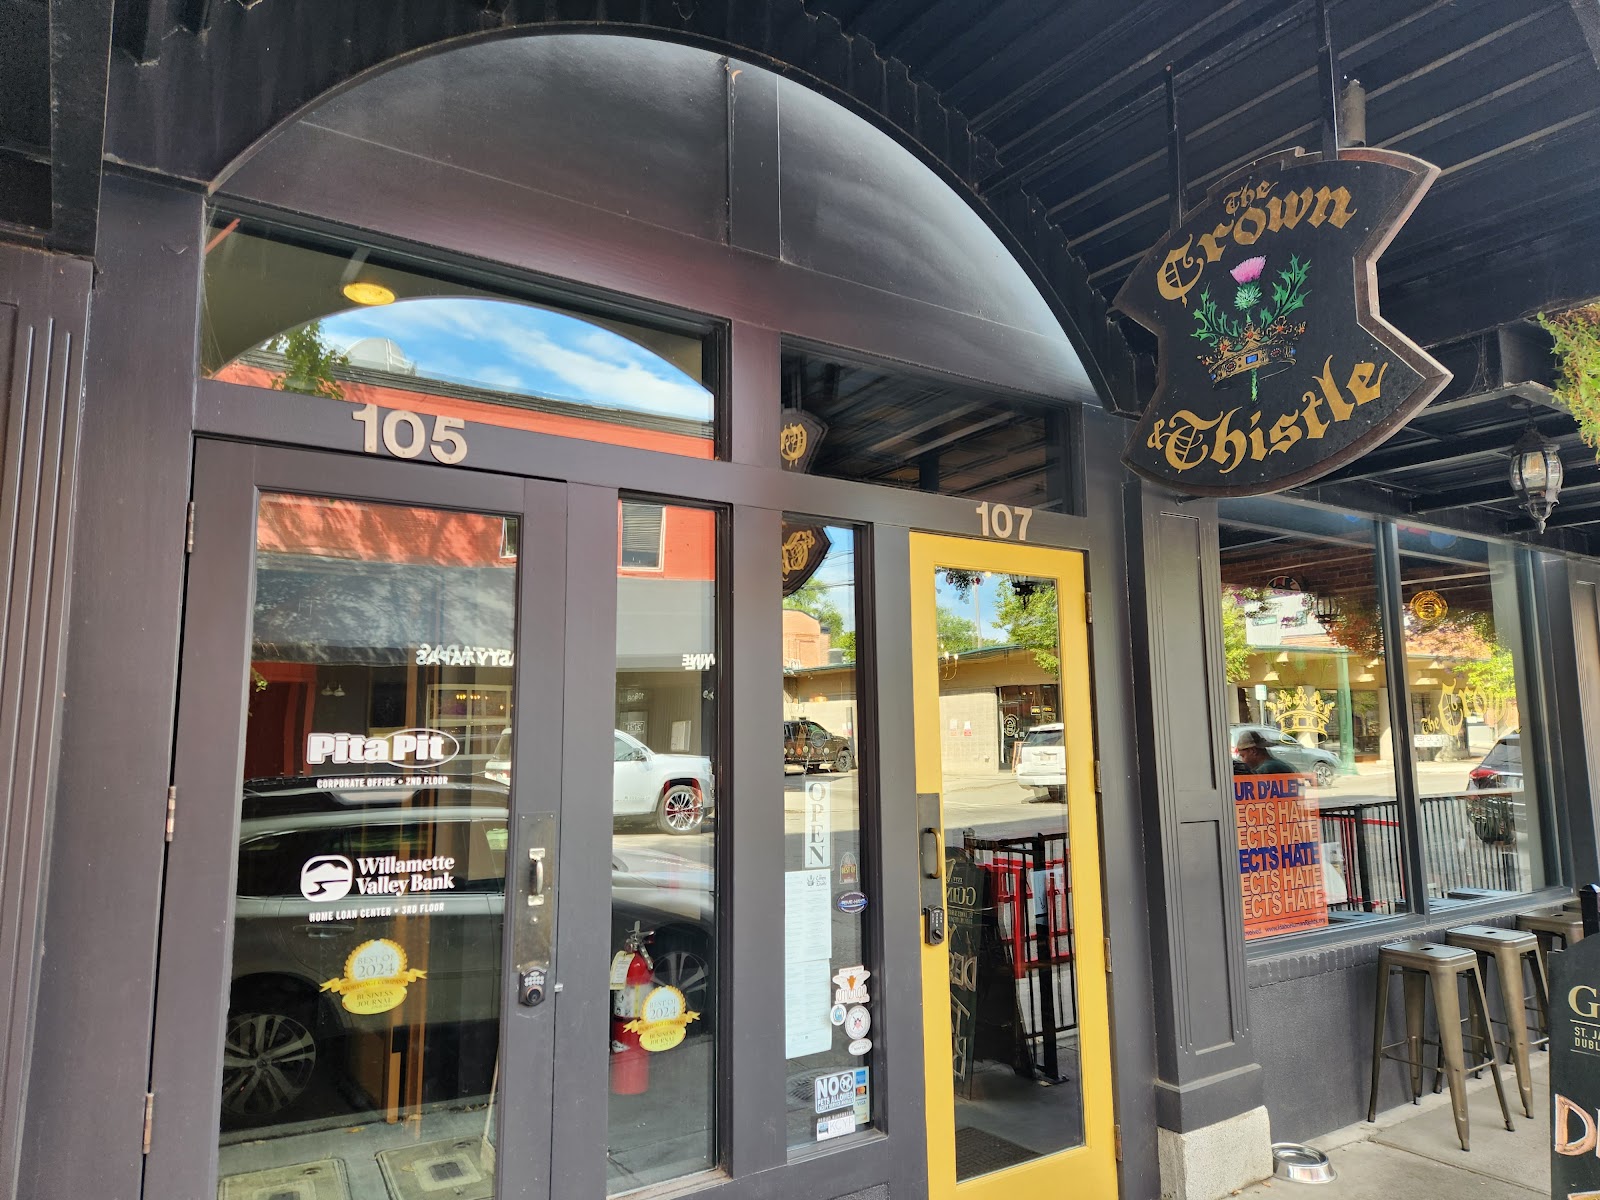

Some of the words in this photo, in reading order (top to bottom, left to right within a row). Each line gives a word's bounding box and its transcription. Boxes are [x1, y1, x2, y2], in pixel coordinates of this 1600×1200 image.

[1223, 180, 1279, 216] The
[1156, 185, 1357, 308] Crown
[1147, 418, 1166, 451] &
[1164, 355, 1389, 473] Thistle
[352, 403, 467, 464] 105
[976, 501, 1033, 540] 107
[1421, 715, 1440, 735] The
[307, 733, 389, 764] Pita
[392, 734, 445, 761] Pit
[317, 778, 365, 788] CORPORATE
[366, 777, 396, 787] OFFICE
[405, 776, 421, 786] 2ND
[423, 776, 448, 785] FLOOR
[808, 782, 826, 865] OPEN
[1235, 802, 1276, 828] ECTS
[1277, 800, 1317, 824] HATE
[1237, 824, 1278, 850] ECTS
[1279, 821, 1318, 846] HATE
[356, 855, 456, 875] Willamette
[1239, 846, 1280, 874] ECTS
[1281, 841, 1320, 868] HATE
[355, 876, 410, 897] Valley
[410, 872, 456, 892] Bank
[1240, 869, 1281, 897] ECTS
[1283, 864, 1323, 891] HATE
[309, 911, 334, 922] HOME
[336, 909, 358, 920] LOAN
[360, 907, 391, 918] CENTER
[401, 904, 418, 914] 3RD
[420, 902, 445, 913] FLOOR
[1242, 891, 1283, 920] ECTS
[1284, 887, 1324, 914] HATE
[358, 956, 378, 964] BEST
[358, 963, 395, 978] 2024
[356, 991, 394, 1000] BUSINESS
[357, 998, 393, 1008] JOURNAL
[650, 1006, 677, 1020] 2024
[817, 1077, 840, 1099] NO
[818, 1097, 830, 1106] PETS
[830, 1092, 854, 1104] ALLOWED
